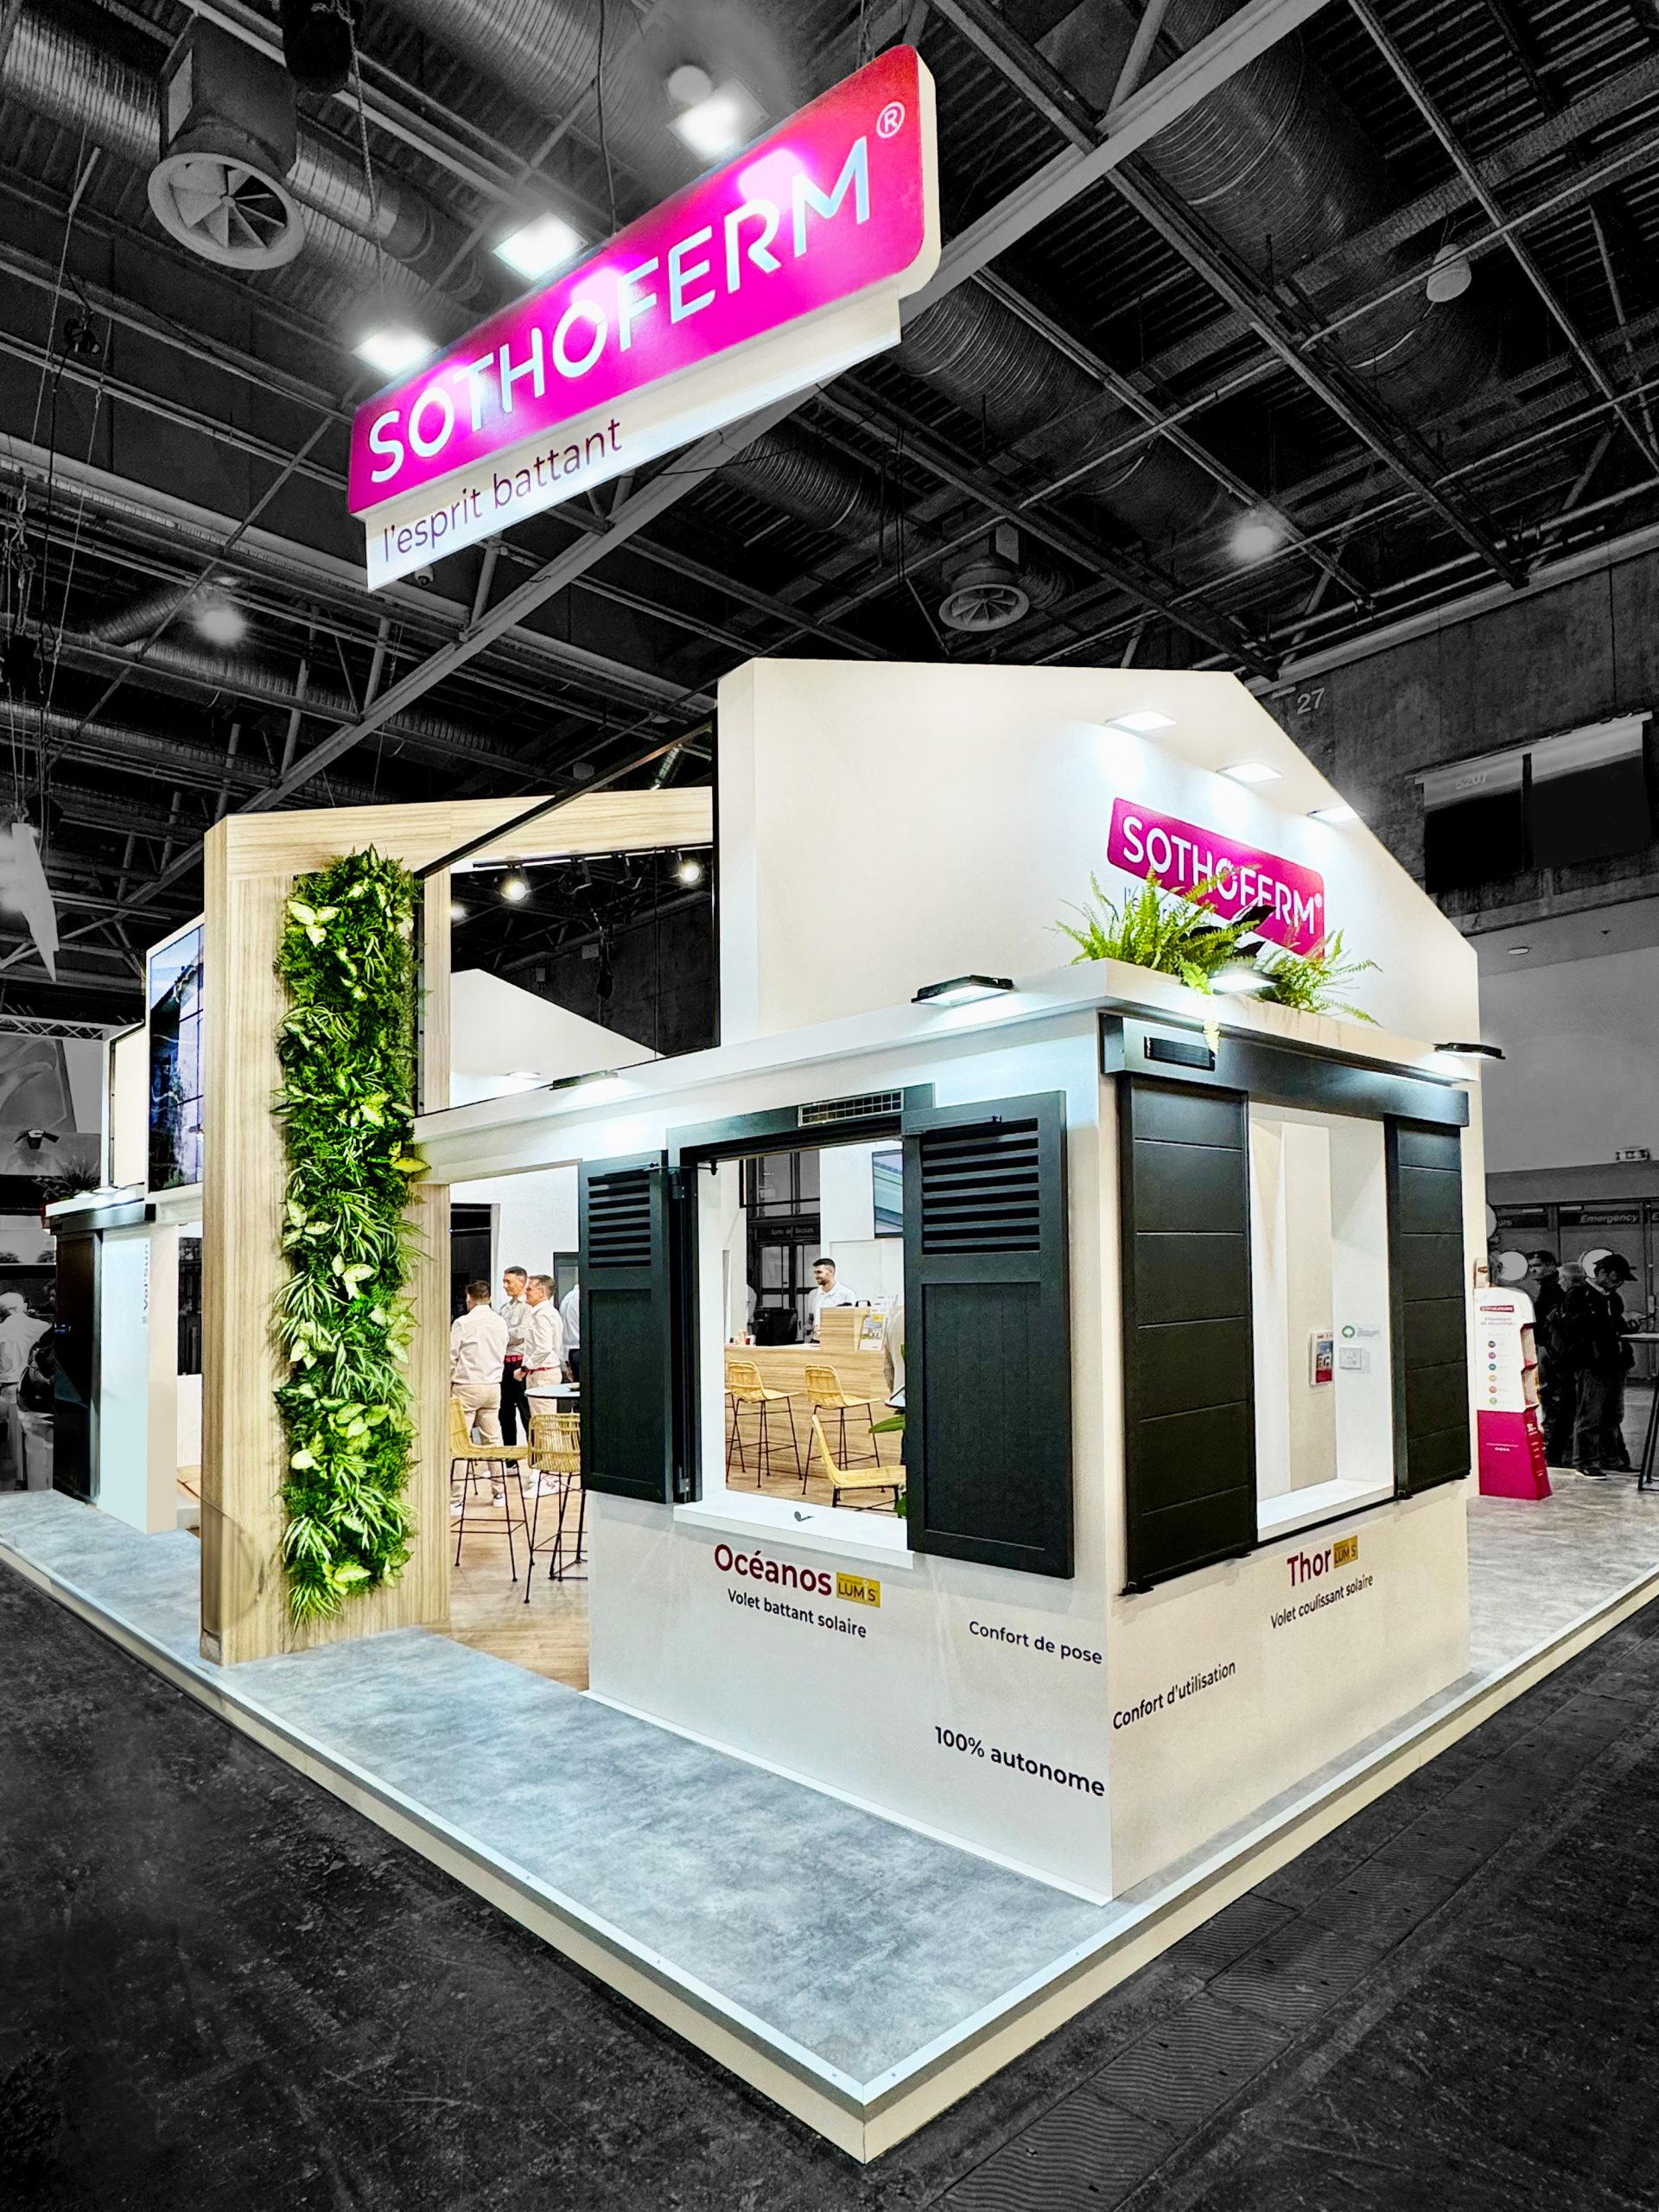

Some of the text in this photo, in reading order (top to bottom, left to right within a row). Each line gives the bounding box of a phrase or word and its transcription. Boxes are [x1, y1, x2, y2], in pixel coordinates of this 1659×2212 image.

[384, 418, 623, 562] l'esprit battant
[1297, 687, 1325, 715] 27
[1580, 1214, 1638, 1224] Emergency
[714, 1543, 832, 1596] Océanos
[1287, 1549, 1332, 1587] Thor
[728, 1588, 867, 1638] Volet battant solaire
[1270, 1573, 1374, 1630] Volet coulissant solaire
[969, 1621, 1103, 1664] Confort de pose
[1113, 1662, 1236, 1730] Confort d'utilisation
[934, 1726, 1105, 1797] 100% autonome
